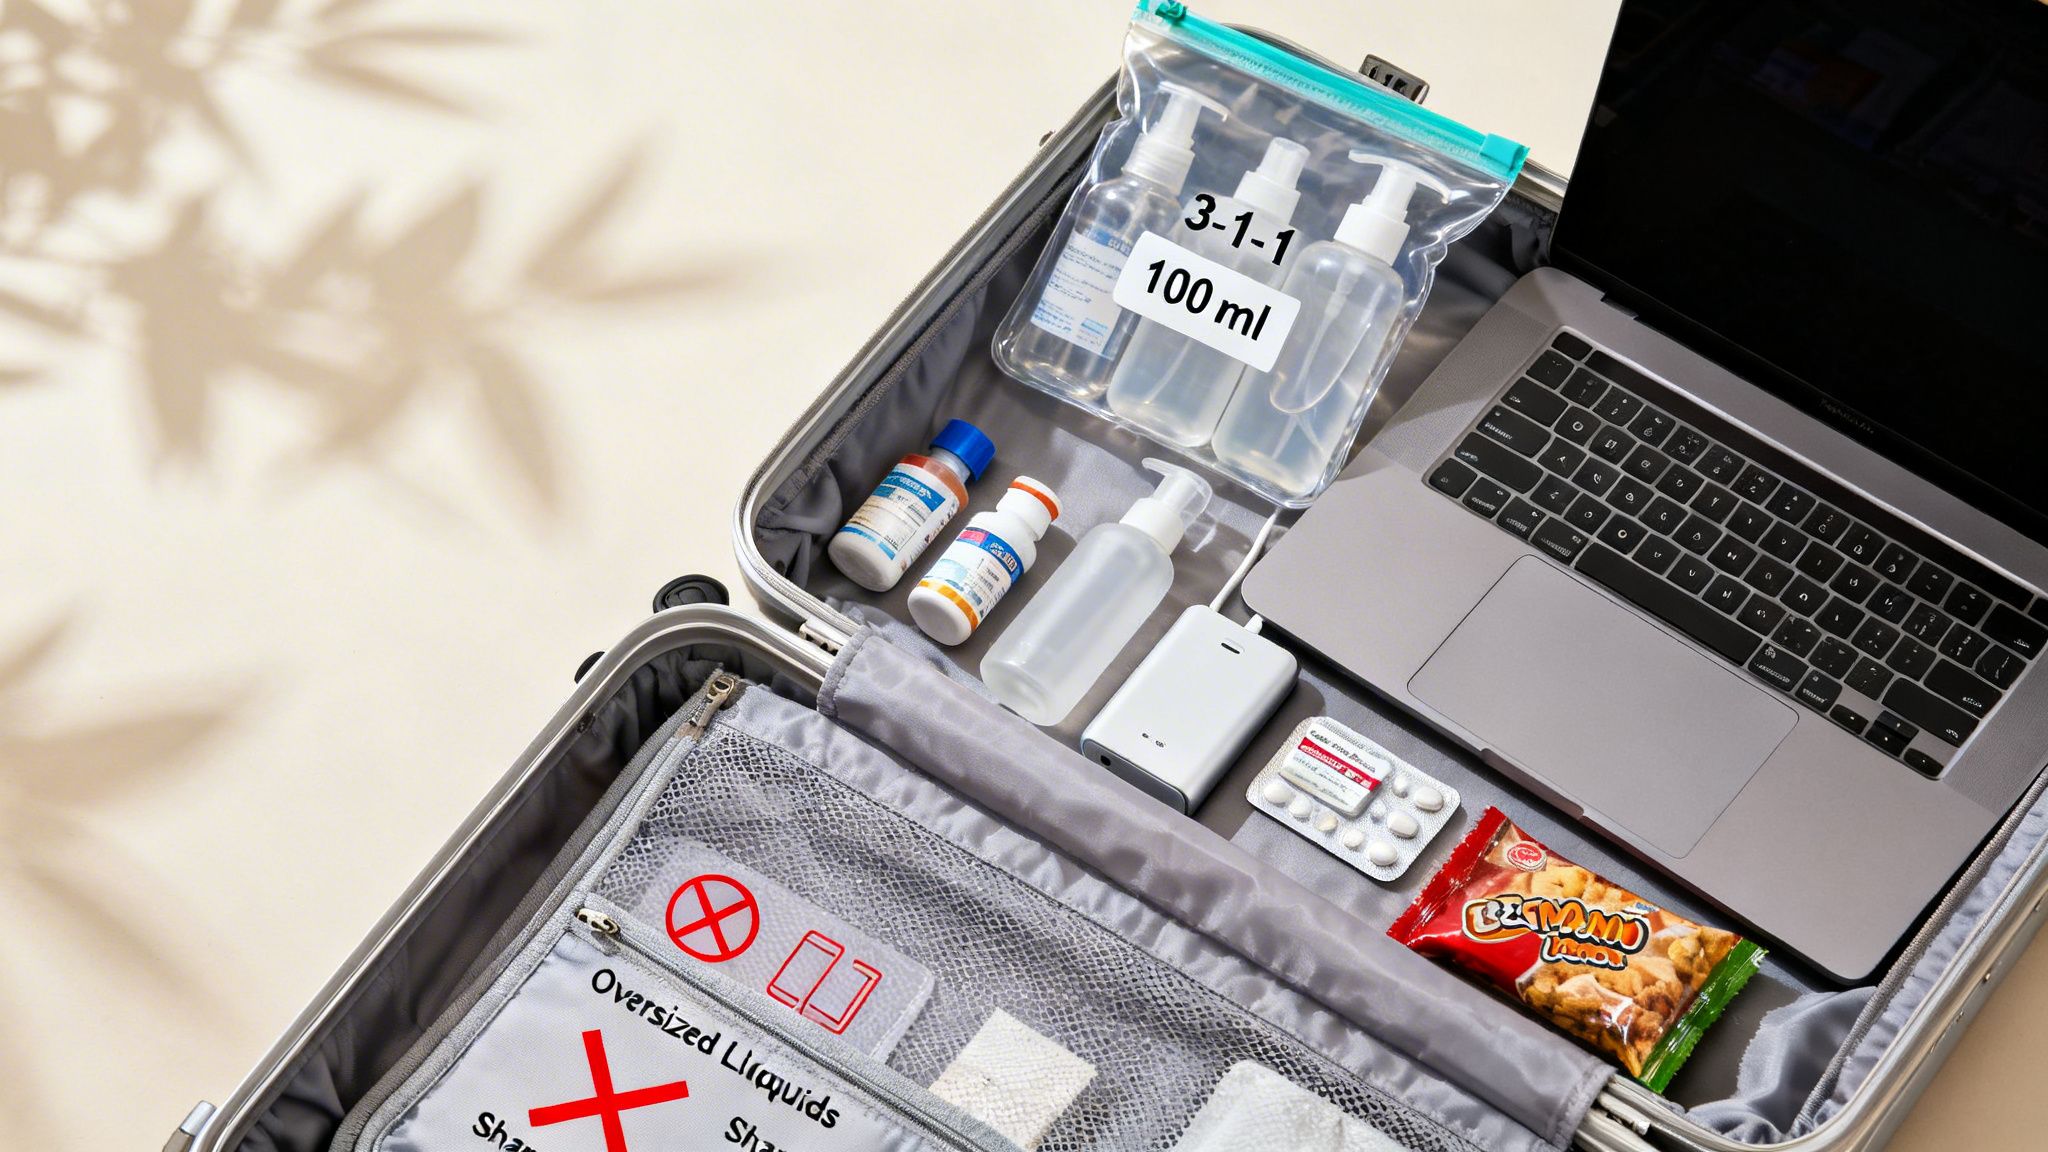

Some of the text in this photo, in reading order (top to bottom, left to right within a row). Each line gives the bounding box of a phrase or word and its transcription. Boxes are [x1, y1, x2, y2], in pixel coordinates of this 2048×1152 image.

[1184, 193, 1296, 267] 3-1-1
[1147, 259, 1214, 315] 100
[1214, 299, 1273, 341] ml
[591, 968, 722, 1056] Oversized
[472, 1111, 537, 1152] Sha
[724, 1116, 788, 1152] Sha
